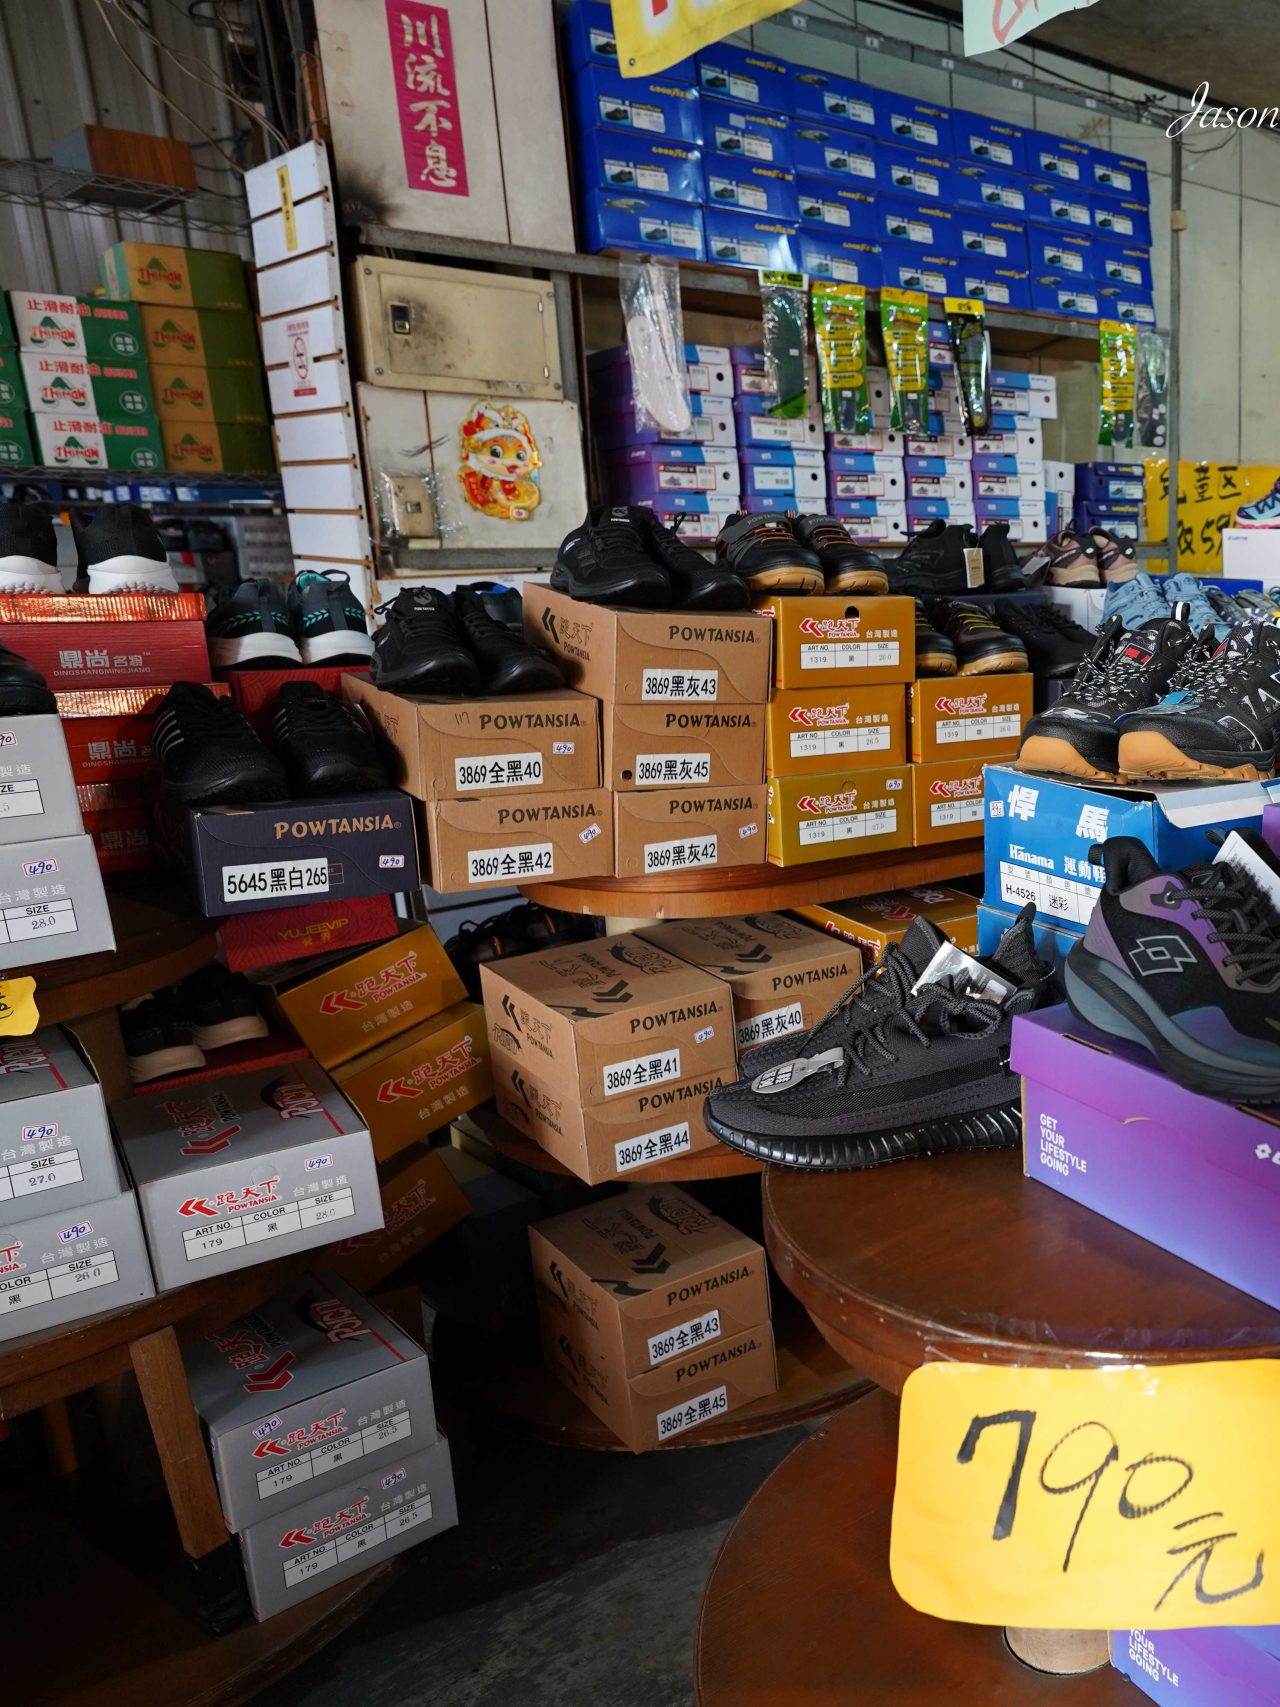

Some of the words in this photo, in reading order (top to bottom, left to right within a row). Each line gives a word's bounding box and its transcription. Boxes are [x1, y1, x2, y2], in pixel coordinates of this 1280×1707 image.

[401, 14, 457, 188] 川流不息
[669, 625, 755, 643] POWTANSIA
[54, 667, 151, 676] DINGSHANGMINGJIANG
[645, 675, 716, 697] 3869黑灰43
[480, 713, 581, 730] POWTANSIA
[665, 713, 751, 728] POWTANSIA
[556, 743, 572, 753] 490
[459, 761, 541, 785] 3869全黑40
[638, 761, 709, 780] 3869黑灰45
[498, 804, 596, 824] POWTANSIA
[669, 797, 753, 814] POWTANSIA
[274, 814, 393, 840] POWTANSIA
[583, 827, 597, 840] 490
[382, 856, 401, 866] 490
[472, 851, 552, 877] 3869全黑42
[647, 843, 716, 868] 3869黑灰42
[28, 863, 53, 875] 490
[227, 868, 328, 895] 5645黑白265
[1006, 884, 1036, 901] H-4526
[25, 905, 51, 915] SIZE
[31, 916, 56, 930] 28.0
[279, 918, 349, 940] YUJEEVIP
[373, 973, 422, 1002] POWTANSIA
[772, 964, 848, 990] POWTANSIA
[630, 1001, 718, 1033] POWTANSIA
[738, 1010, 803, 1045] 3869黑灰40
[429, 1059, 477, 1089] POWTANSIA
[606, 1058, 678, 1090] 3869全黑41
[639, 1078, 723, 1112] POWTANSIA
[27, 1126, 54, 1138] 490
[1040, 1113, 1057, 1130] GET
[1, 1135, 72, 1161] 台灣製造
[618, 1129, 689, 1166] 3869全黑44
[1040, 1126, 1064, 1148] YOUR
[30, 1157, 56, 1169] SIZE
[308, 1159, 327, 1168] 490
[1040, 1138, 1087, 1173] LIFESTYLE
[1040, 1153, 1069, 1176] GOING
[216, 1178, 278, 1207] 跑天下
[293, 1175, 348, 1197] 台灣製造
[195, 1225, 213, 1237] ART
[217, 1221, 233, 1231] NO.
[253, 1207, 286, 1221] COLOR
[315, 1194, 334, 1205] SIZE
[228, 1195, 277, 1213] POWTANSIA
[64, 1223, 86, 1241] 490
[39, 1237, 109, 1264] 台灣製造
[201, 1238, 223, 1250] 179
[68, 1260, 92, 1272] SIZE
[667, 1266, 751, 1306] POWTANSIA
[652, 1319, 720, 1359] 3869全黑43
[676, 1340, 757, 1382] POWTANSIA
[660, 1395, 727, 1434] 3869全黑45
[258, 1420, 278, 1437] 490
[287, 1410, 345, 1443] 跑天下
[267, 1463, 284, 1476] ART
[320, 1438, 351, 1454] COLOR
[377, 1420, 394, 1431] SIZE
[297, 1427, 345, 1450] POWTANSIA
[273, 1475, 293, 1488] 179
[294, 1553, 309, 1565] ART
[345, 1523, 374, 1540] COLOR
[399, 1503, 416, 1515] SIZE
[322, 1514, 369, 1537] POWTANSIA
[299, 1563, 318, 1576] 179
[1129, 1628, 1154, 1653] YOUR
[1128, 1639, 1180, 1687] LIFESTYLE
[1129, 1650, 1160, 1682] GOING
